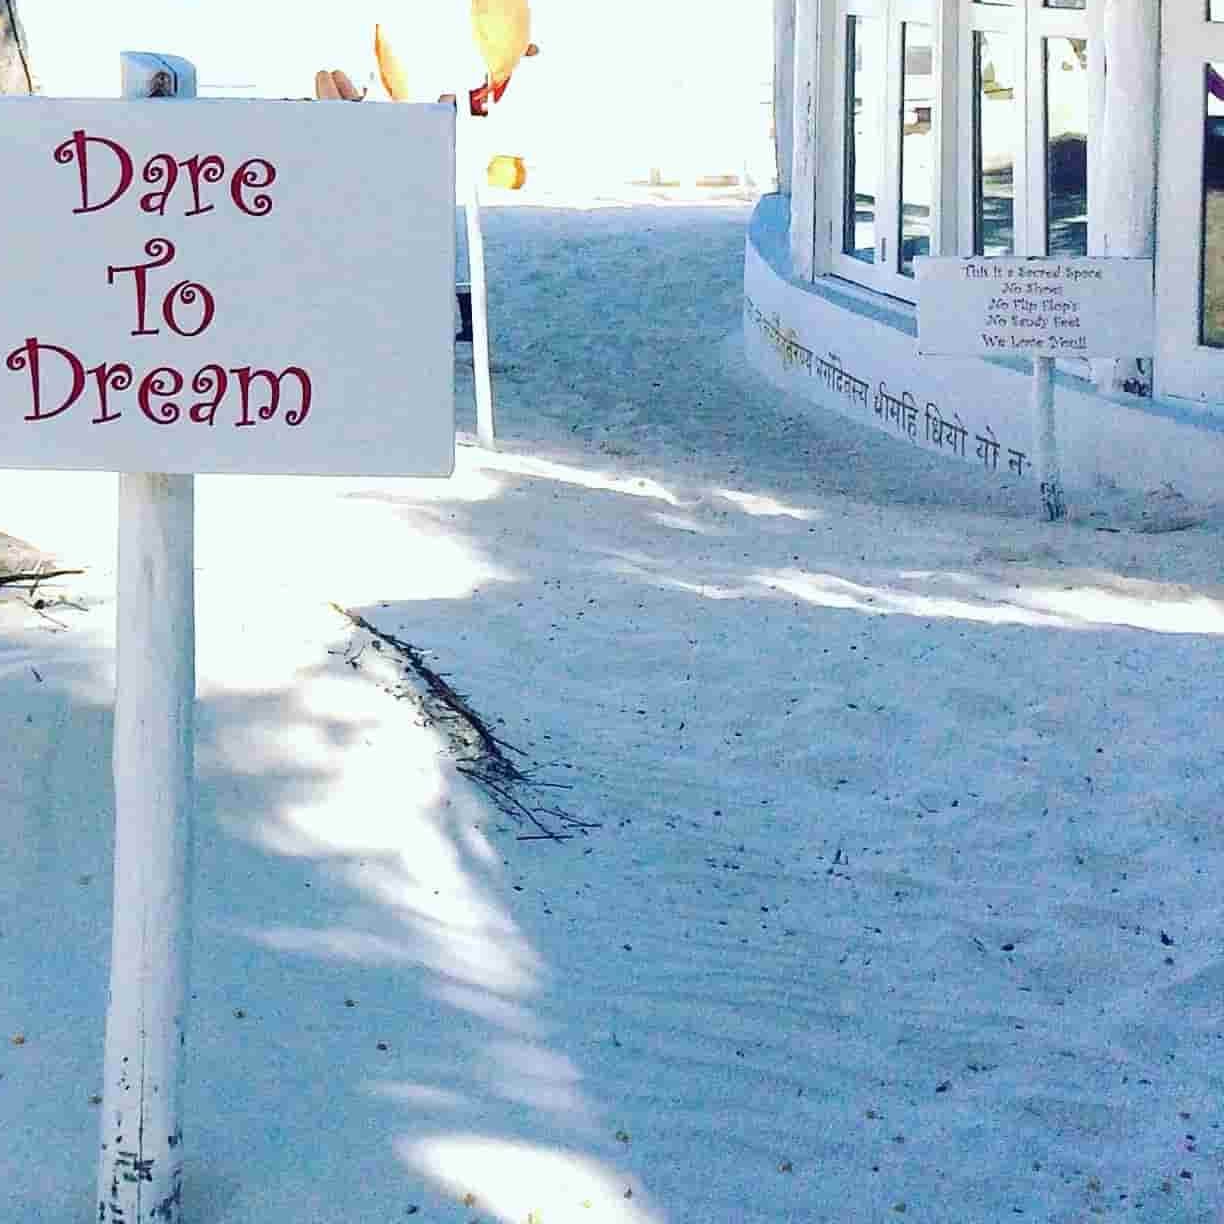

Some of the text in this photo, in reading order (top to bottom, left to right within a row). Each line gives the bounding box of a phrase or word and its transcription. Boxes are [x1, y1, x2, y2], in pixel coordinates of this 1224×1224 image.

[54, 130, 276, 216] Dare
[108, 238, 214, 336] To
[1001, 281, 1022, 294] No
[987, 297, 1009, 311] No
[985, 314, 1007, 327] No
[981, 333, 1006, 348] We
[7, 338, 311, 426] Dream
